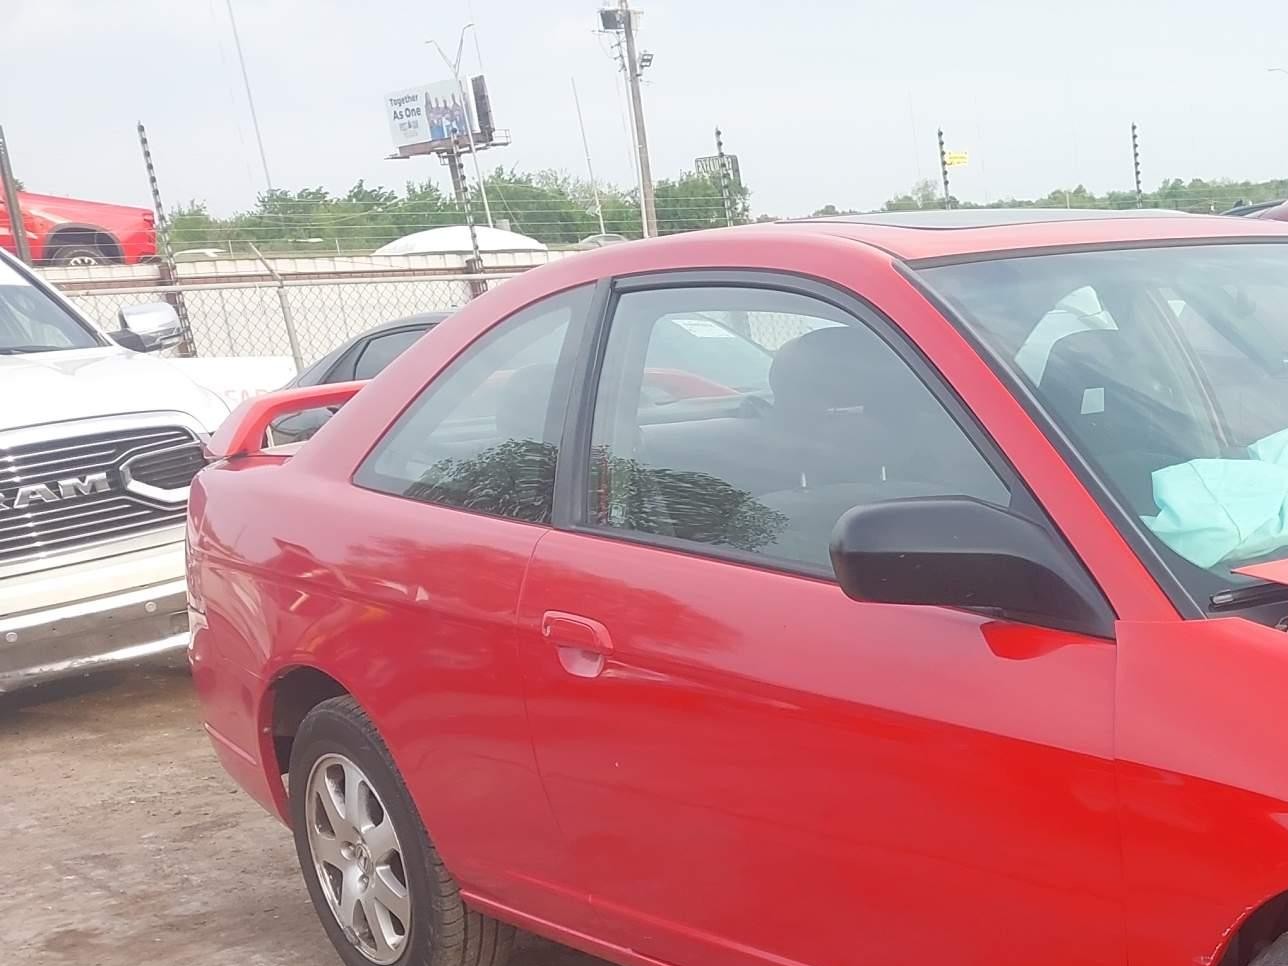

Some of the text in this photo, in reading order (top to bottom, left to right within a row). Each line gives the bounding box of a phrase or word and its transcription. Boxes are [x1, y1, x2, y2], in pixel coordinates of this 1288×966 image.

[389, 94, 418, 107] Together
[393, 107, 421, 121] As One
[0, 471, 111, 511] AM
